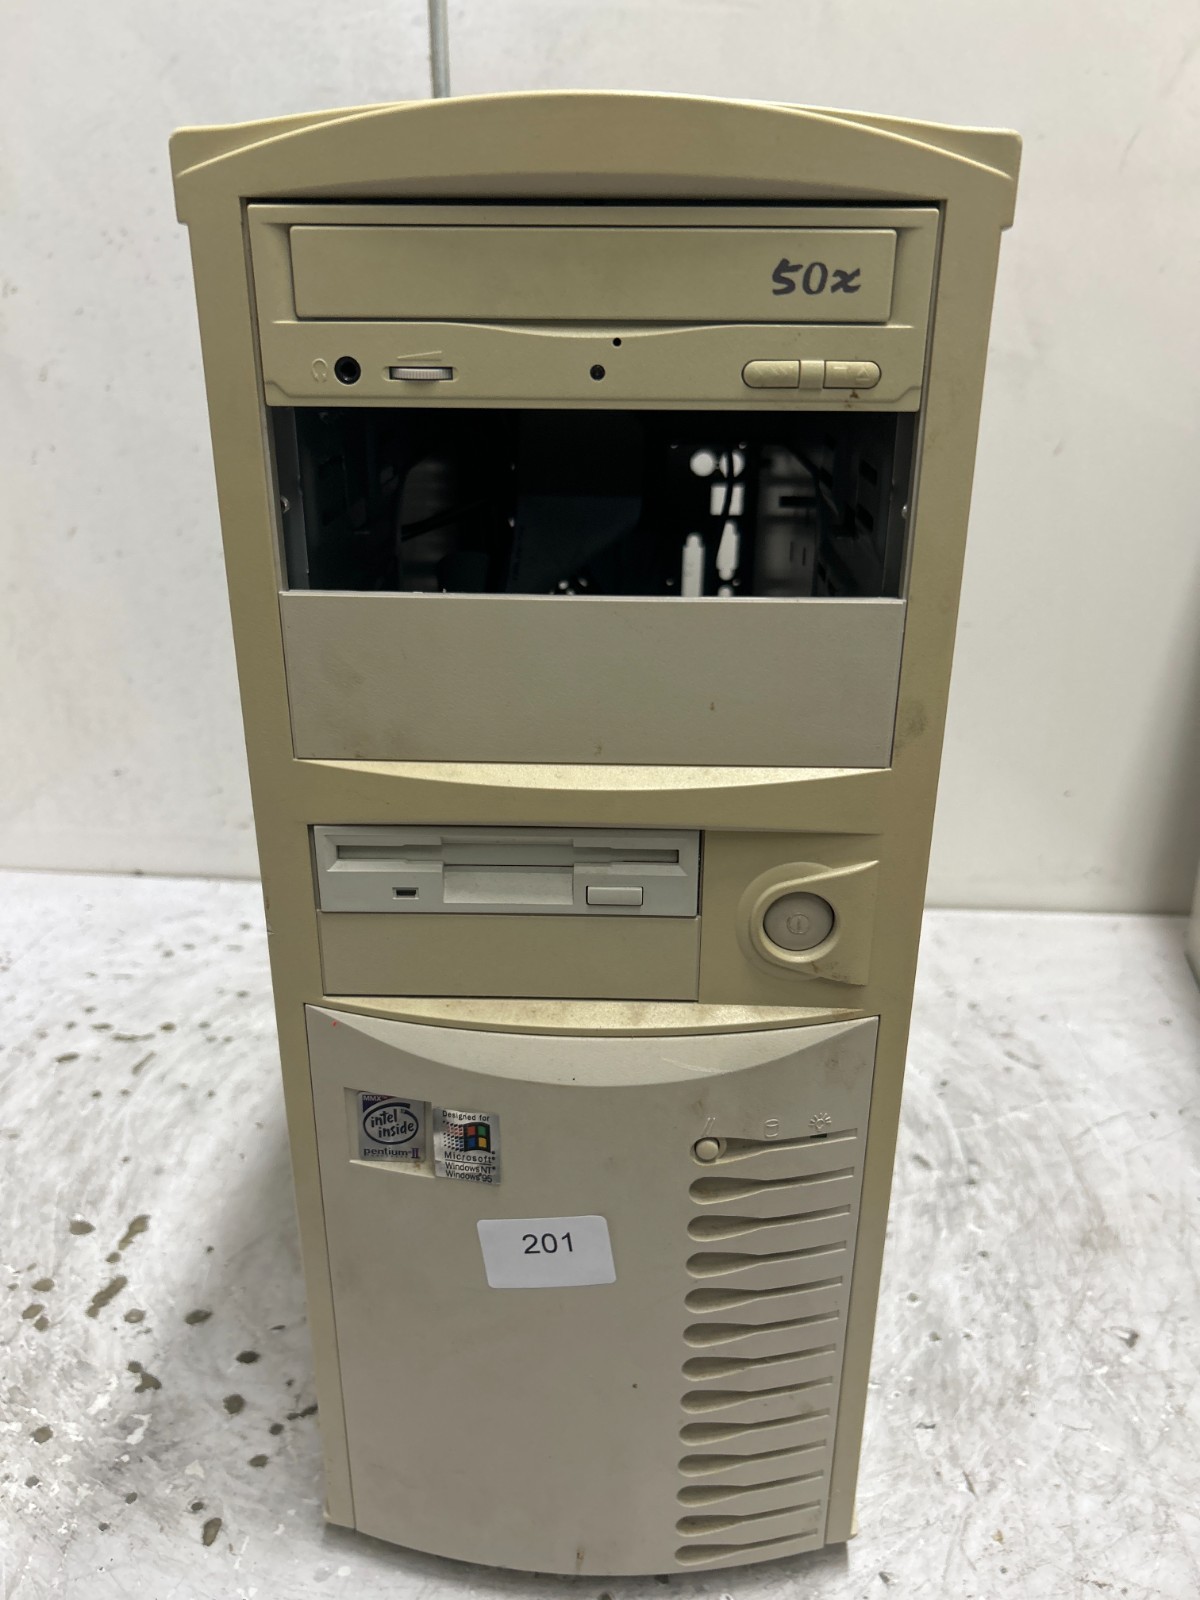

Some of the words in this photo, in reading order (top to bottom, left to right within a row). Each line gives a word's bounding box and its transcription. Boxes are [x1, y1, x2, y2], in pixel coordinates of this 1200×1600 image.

[772, 258, 861, 296] 50x
[371, 1108, 398, 1128] intel
[442, 1110, 476, 1121] Designed
[479, 1114, 490, 1122] for
[379, 1120, 415, 1138] inside
[363, 1147, 408, 1157] pentium
[445, 1162, 480, 1173] Windows
[522, 1231, 573, 1254] 201
